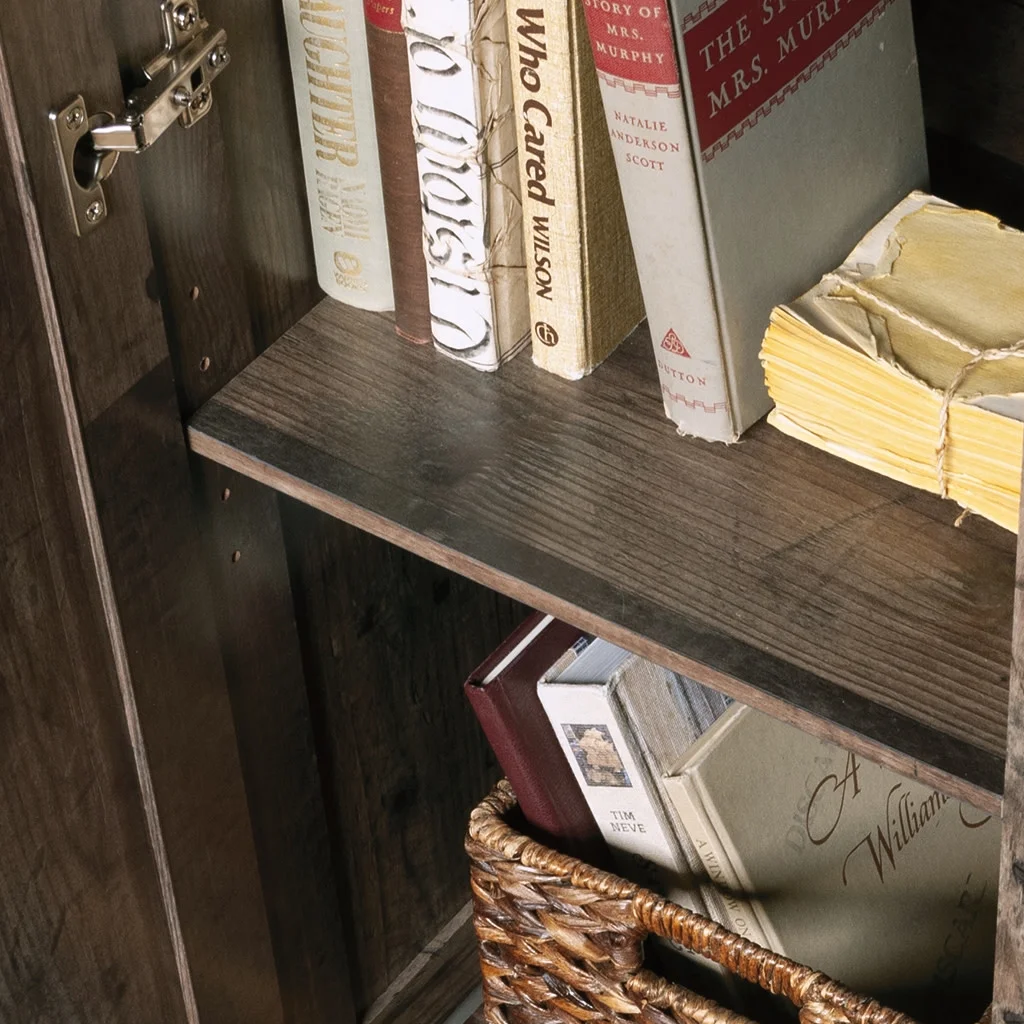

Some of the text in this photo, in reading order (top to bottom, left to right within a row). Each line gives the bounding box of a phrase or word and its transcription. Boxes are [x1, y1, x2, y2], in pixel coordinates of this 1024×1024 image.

[367, 0, 395, 14] apers
[639, 6, 661, 19] OF
[606, 23, 644, 41] MRS.
[699, 15, 752, 72] THE
[596, 41, 665, 65] MURPHY
[298, 0, 360, 167] AUGHTER
[707, 54, 768, 119] MRS.
[614, 110, 668, 133] NATALIE
[610, 129, 680, 153] ANDERSON
[516, 8, 556, 301] Who Cared WILSON
[626, 152, 665, 171] SCOTT
[658, 359, 707, 386] DUTTON
[610, 810, 636, 821] TIM
[610, 822, 647, 834] NEVE
[842, 782, 951, 887] William
[695, 838, 708, 849] A
[734, 917, 752, 937] ON
